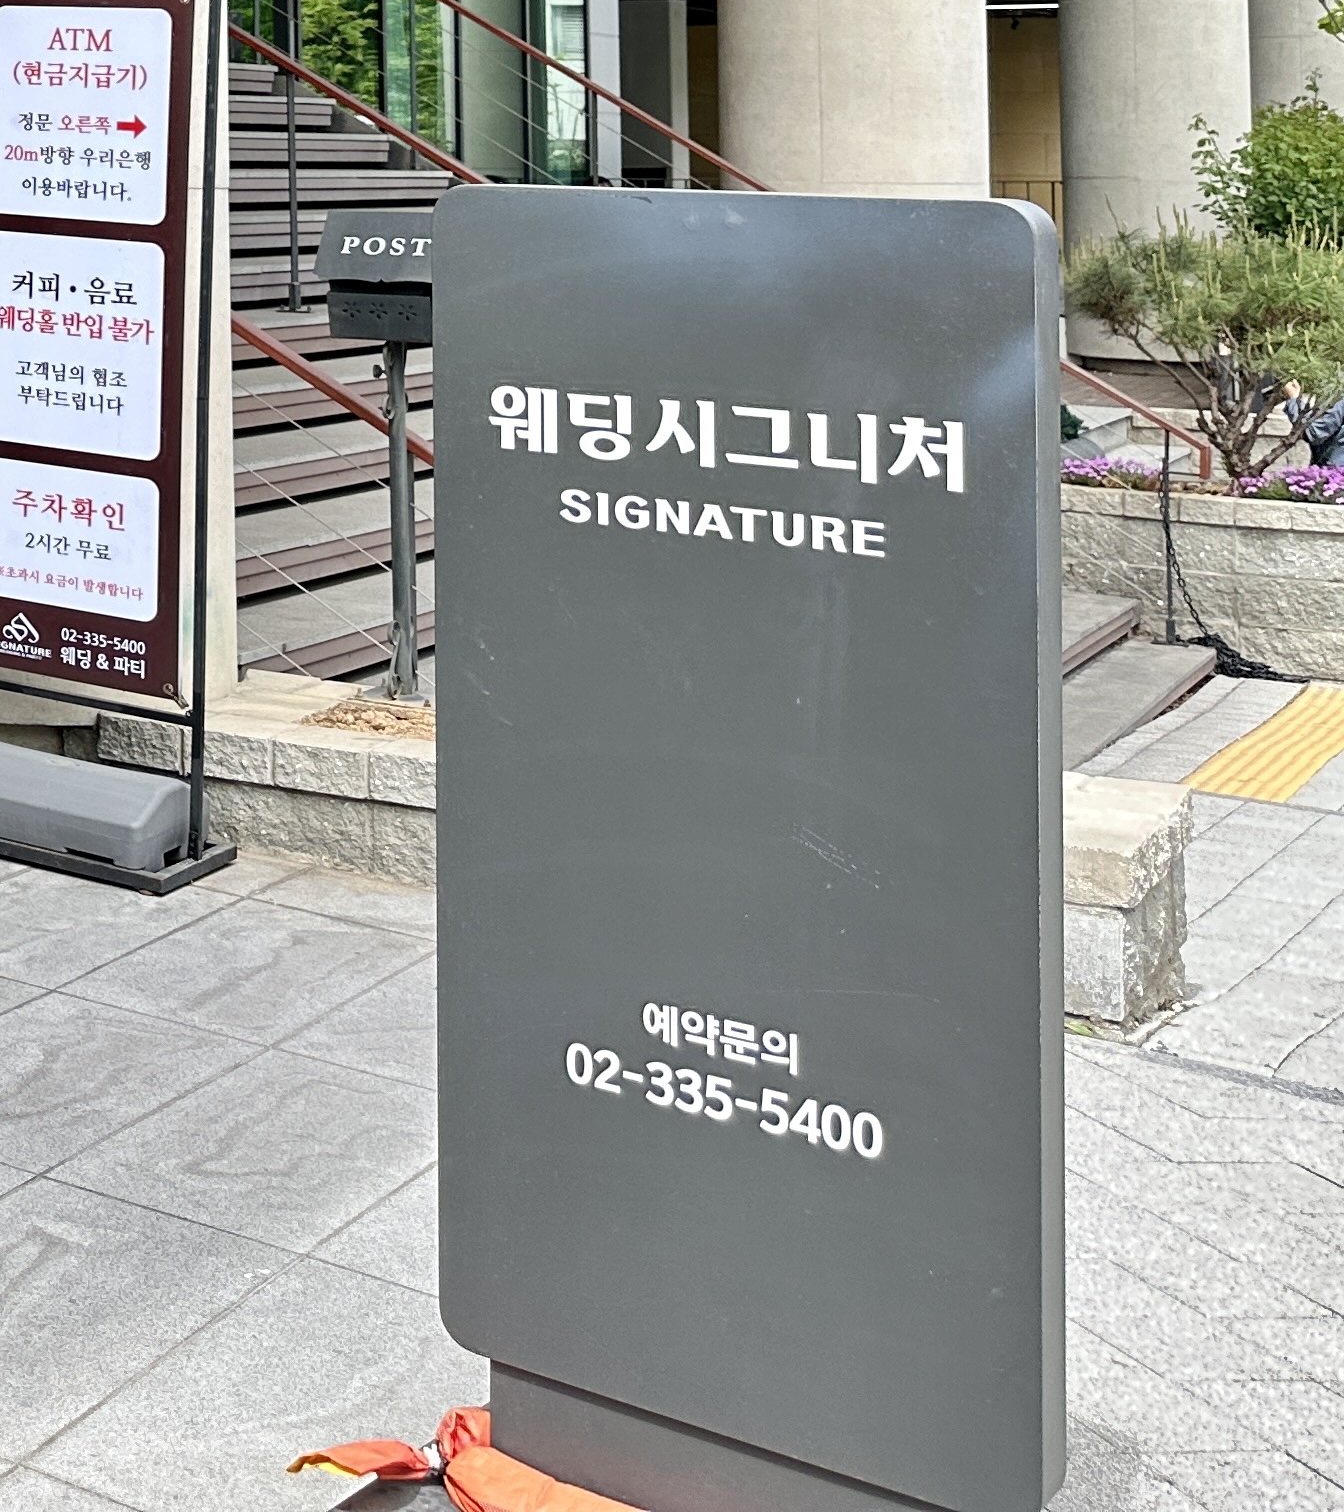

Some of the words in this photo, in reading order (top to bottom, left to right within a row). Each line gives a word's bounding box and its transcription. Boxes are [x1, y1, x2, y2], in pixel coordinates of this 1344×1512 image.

[46, 26, 114, 53] ATM
[12, 60, 148, 91] (현금지급기)
[17, 111, 53, 132] 정문
[57, 114, 112, 136] 오른쪽
[4, 144, 75, 166] 20m방향
[79, 147, 151, 171] 우리은행
[21, 176, 132, 202] 이용바랍니다.
[340, 236, 433, 258] POST
[61, 311, 104, 340] 반입
[107, 316, 155, 346] 불가
[15, 360, 85, 386] 고객님의
[91, 367, 128, 388] 협조
[17, 384, 125, 417] 부탁드립니다
[488, 384, 965, 494] 웨딩시그니처
[11, 488, 126, 532] 주차확인
[558, 487, 886, 558] SIGNATURE
[24, 532, 71, 557] 2시간
[75, 539, 113, 562] 무료
[43, 570, 80, 591] 요금이
[82, 578, 144, 602] 발생합니다
[60, 626, 147, 656] 02-335-5400
[60, 646, 93, 671] 웨딩
[95, 653, 110, 671] &
[113, 656, 147, 680] 파티
[641, 1001, 800, 1076] 예약문의
[565, 1042, 884, 1161] 02-335-5400
